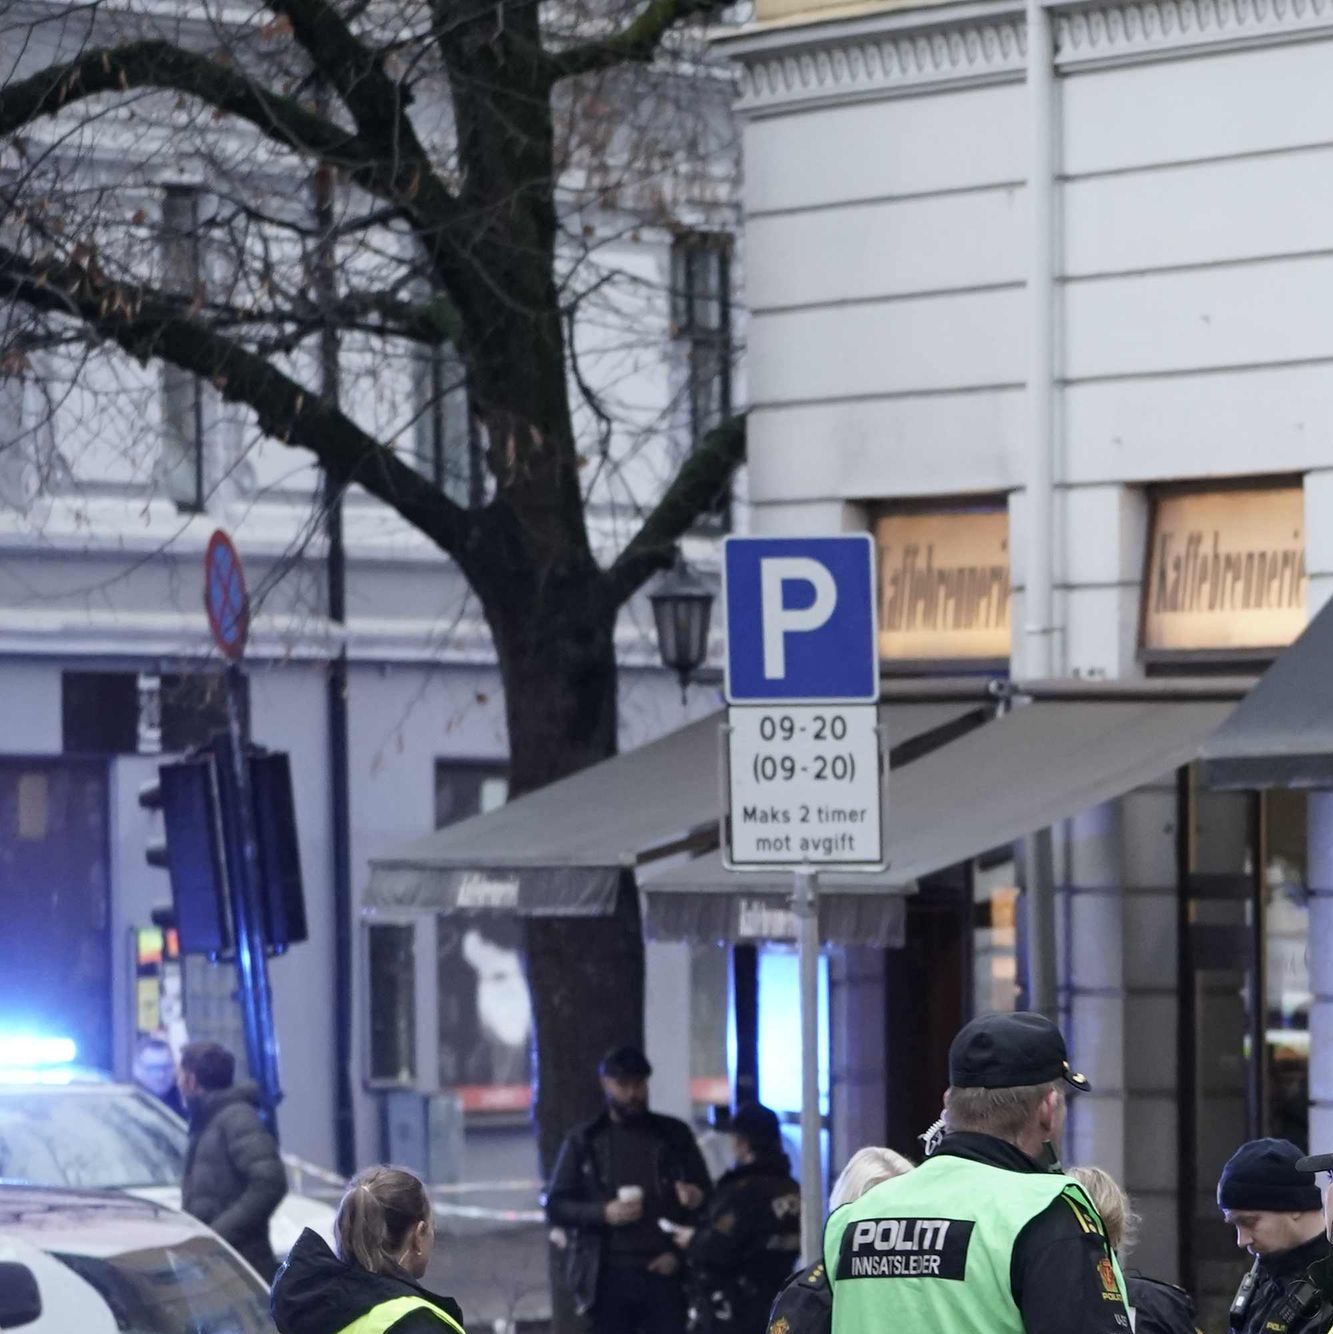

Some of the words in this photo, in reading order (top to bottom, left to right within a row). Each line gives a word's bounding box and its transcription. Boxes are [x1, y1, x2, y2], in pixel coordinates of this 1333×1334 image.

[761, 557, 837, 680] P
[743, 806, 791, 824] Maks
[800, 805, 811, 824] 2
[817, 806, 867, 824] timer
[756, 836, 791, 851] mot
[800, 833, 856, 856] avgift
[852, 1220, 950, 1252] POLITI
